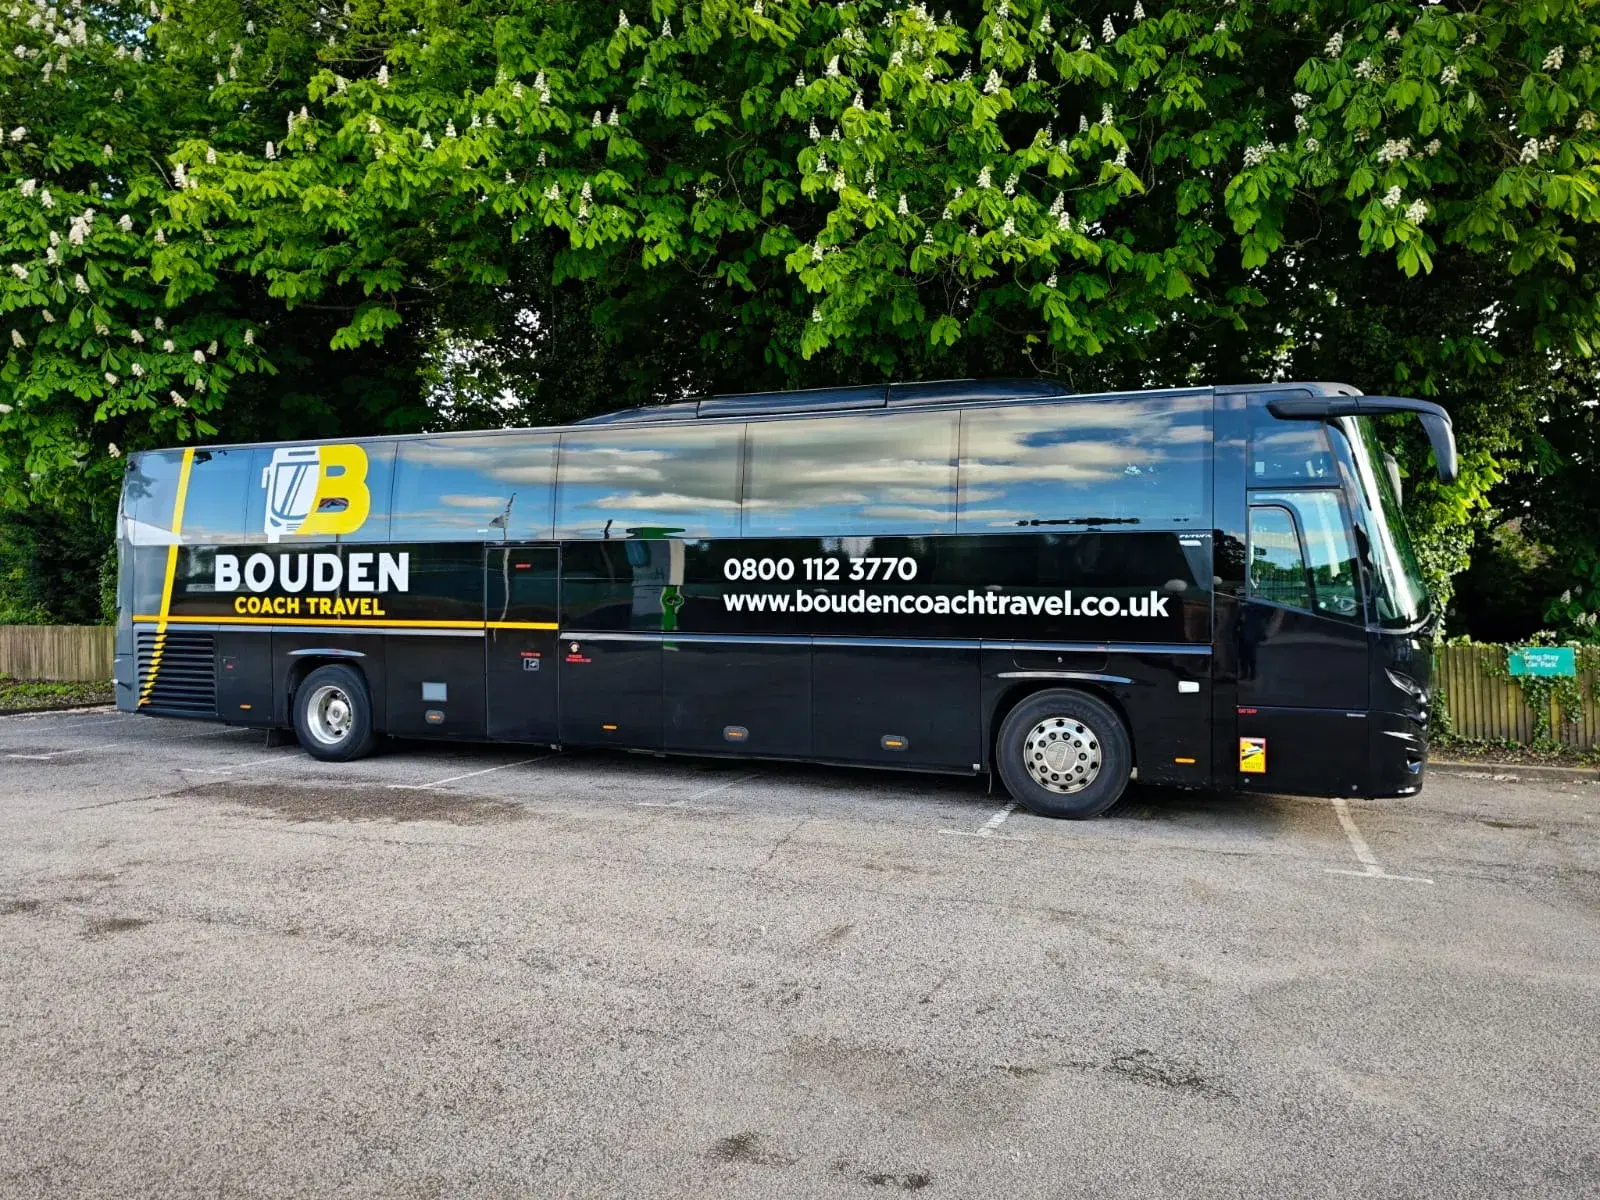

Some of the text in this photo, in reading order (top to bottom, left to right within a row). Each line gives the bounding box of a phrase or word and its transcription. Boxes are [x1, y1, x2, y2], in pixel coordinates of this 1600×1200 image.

[213, 552, 410, 593] BOUDEN
[723, 556, 918, 581] 0800 112 3770
[234, 596, 386, 616] COACH TRAVEL
[723, 589, 1169, 618] www.boudencoachtravel.co.uk
